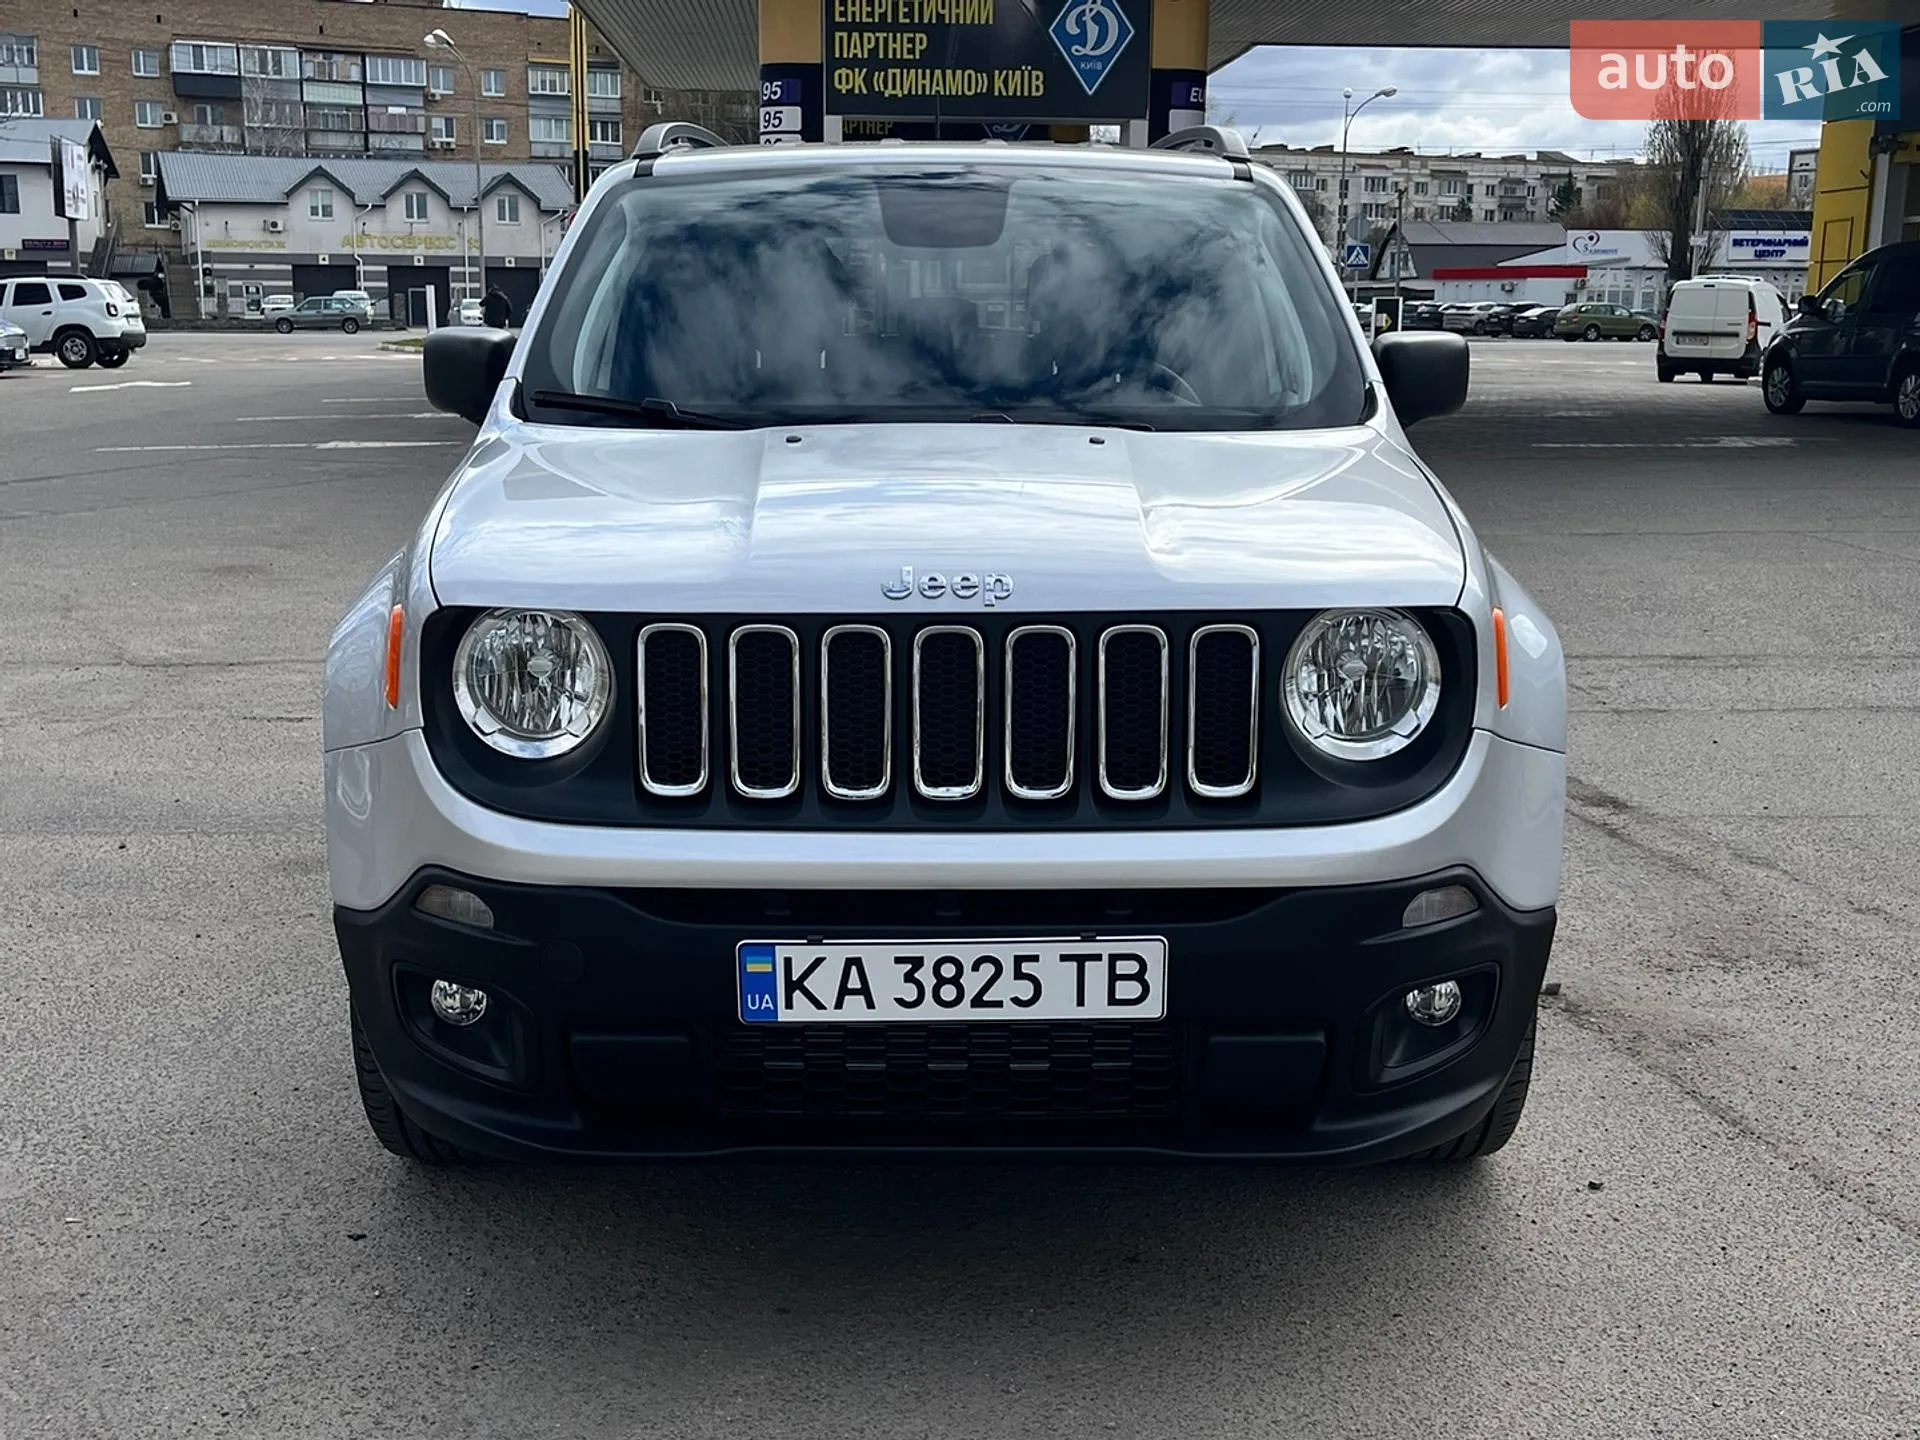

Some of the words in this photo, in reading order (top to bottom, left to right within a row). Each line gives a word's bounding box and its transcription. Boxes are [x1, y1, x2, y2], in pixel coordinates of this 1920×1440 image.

[834, 31, 928, 60] ПАРТНЕР
[762, 81, 783, 101] 95
[833, 67, 868, 95] ФК
[873, 68, 988, 98] «ДИНАМО»
[993, 65, 1045, 97] КИЇВ
[762, 111, 784, 130] 95
[880, 564, 1014, 607] Jeep
[782, 955, 876, 1011] KA
[893, 954, 1043, 1009] 3825
[1058, 952, 1151, 1008] TB
[747, 993, 774, 1010] UA
